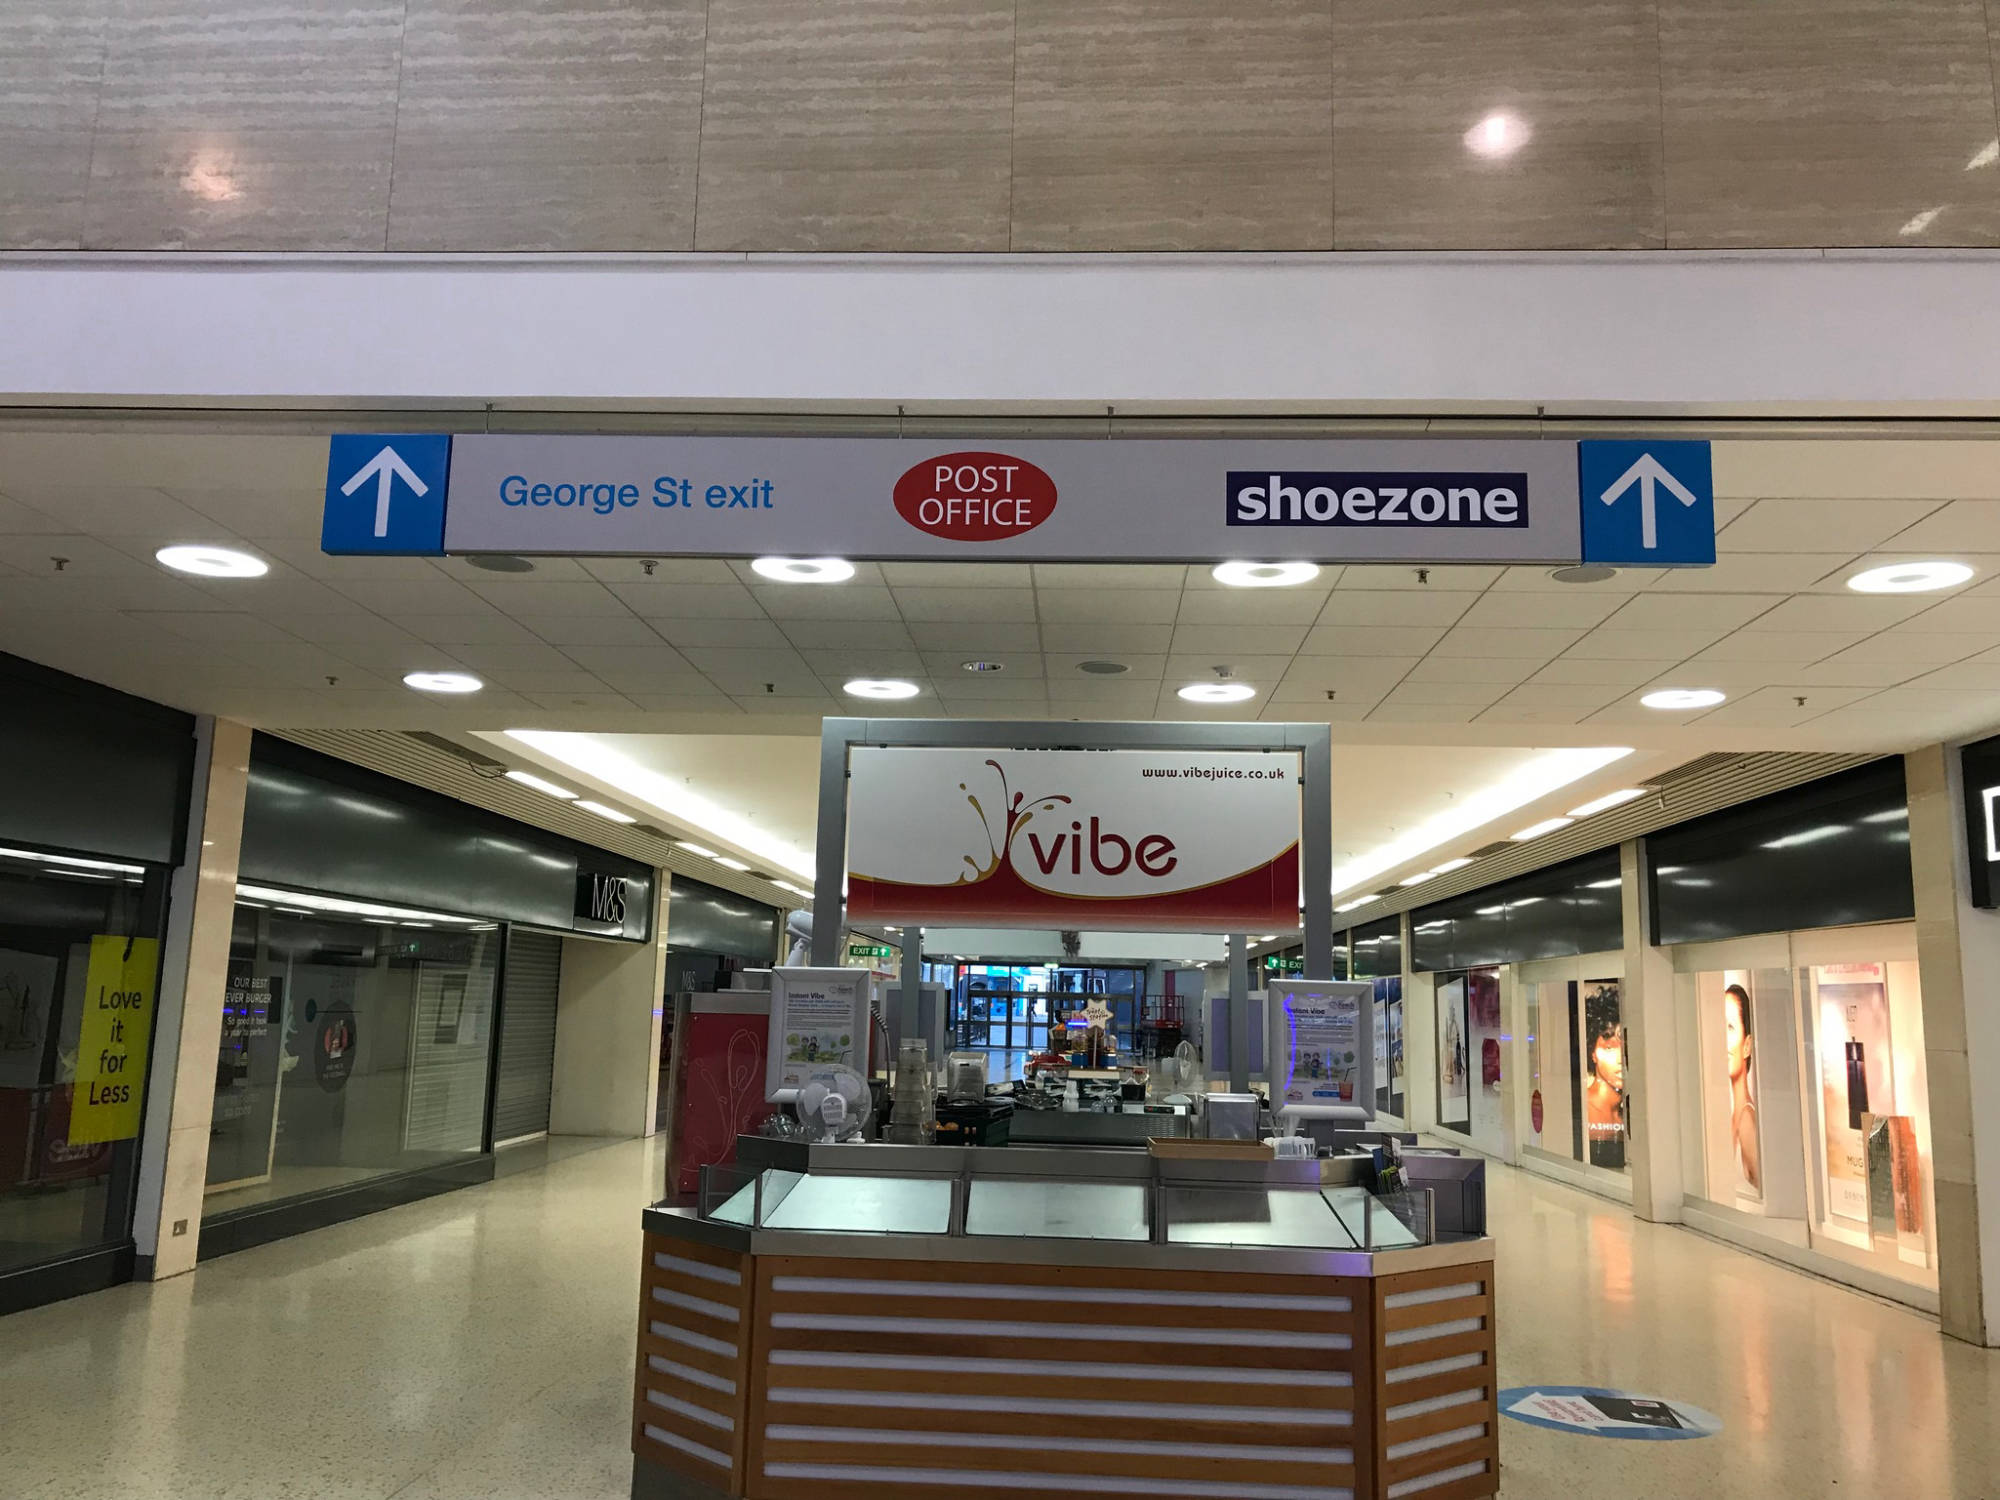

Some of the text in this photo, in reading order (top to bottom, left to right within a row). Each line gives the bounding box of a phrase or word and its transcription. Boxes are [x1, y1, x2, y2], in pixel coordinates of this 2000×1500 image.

[934, 465, 1018, 494] POST
[499, 476, 774, 515] George St exit
[1237, 476, 1518, 521] shoezone
[918, 498, 1032, 526] OFFICE
[1142, 767, 1284, 781] www.vibejuice.co.uk
[1027, 816, 1178, 877] vibe
[591, 873, 627, 923] M&S
[853, 947, 870, 955] EXIT
[99, 986, 142, 1011] Love
[110, 1018, 124, 1042] it
[99, 1050, 128, 1073] for
[89, 1081, 130, 1106] Less
